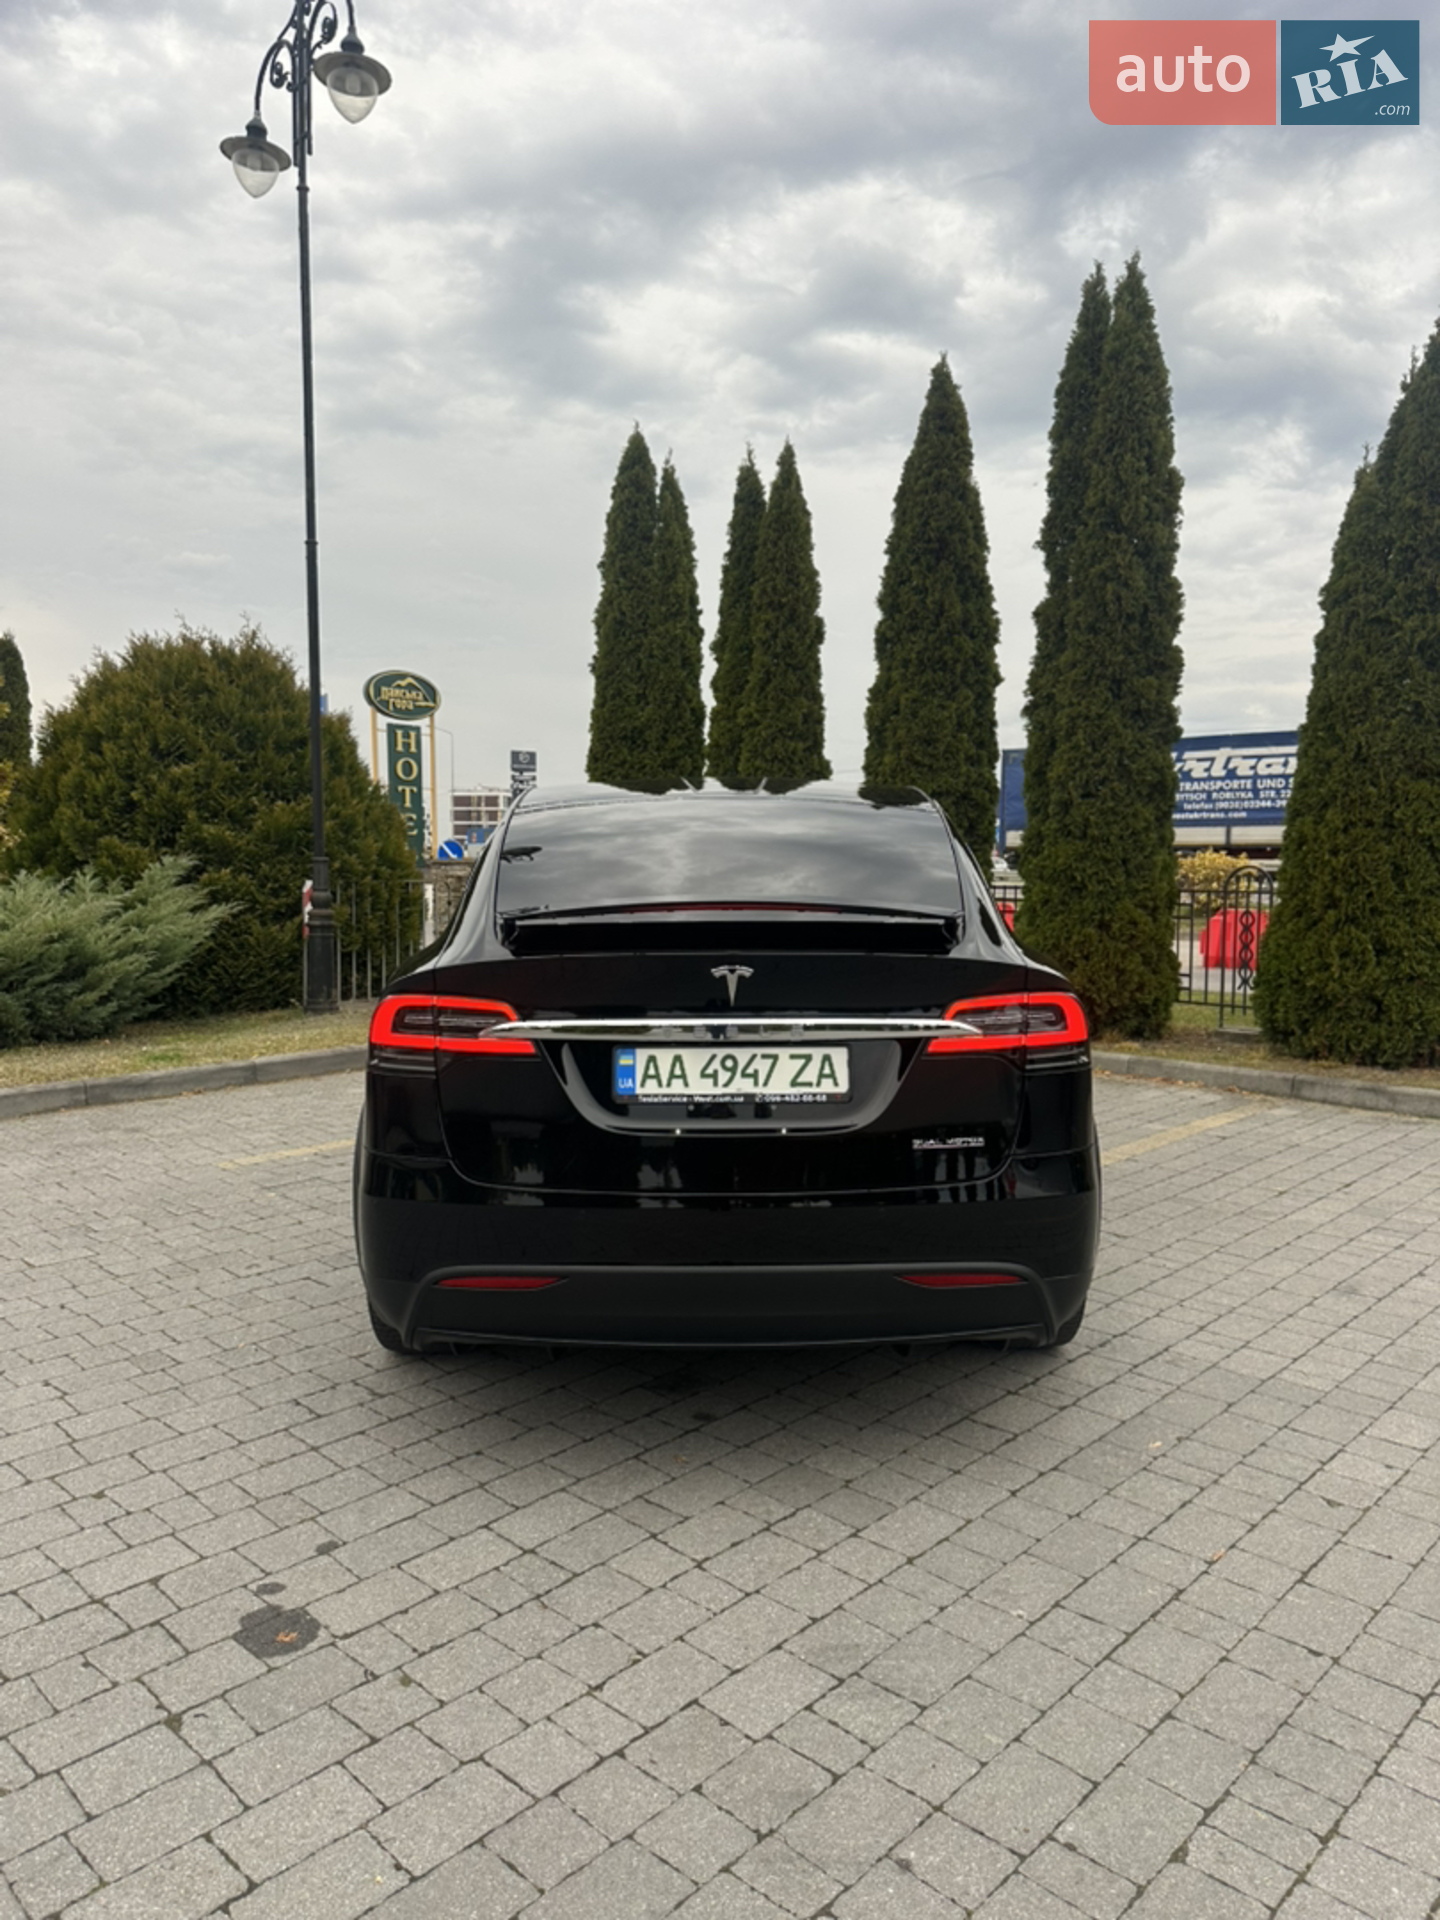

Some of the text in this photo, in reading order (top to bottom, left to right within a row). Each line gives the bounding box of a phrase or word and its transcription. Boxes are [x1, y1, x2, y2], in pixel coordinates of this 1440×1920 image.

[395, 729, 419, 857] HOTE
[1179, 779, 1253, 792] TRANSPORTE
[1257, 778, 1287, 789] UND
[639, 1053, 840, 1088] AA 4947 ZA
[618, 1078, 634, 1088] UA
